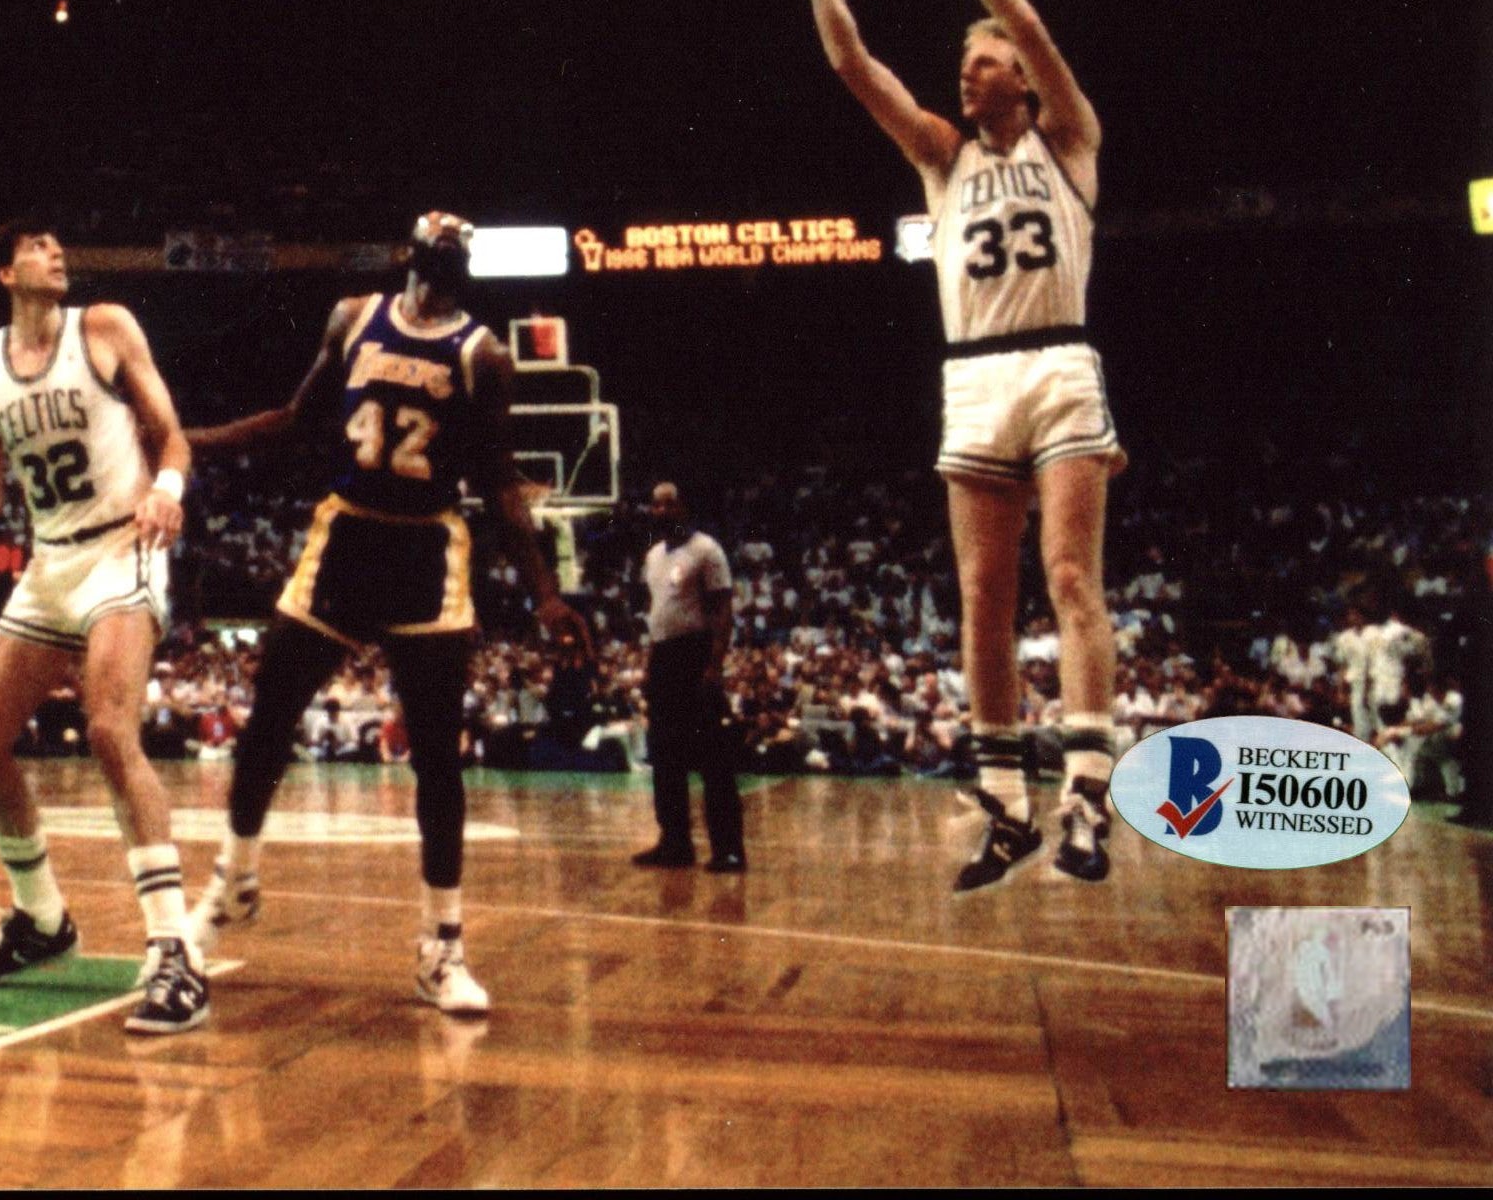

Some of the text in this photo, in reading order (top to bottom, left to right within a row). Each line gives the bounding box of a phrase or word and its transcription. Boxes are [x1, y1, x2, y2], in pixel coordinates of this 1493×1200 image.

[626, 219, 855, 248] BOSTON CELTICS
[699, 245, 764, 266] WORLD
[773, 240, 881, 264] CHAMPIONS
[964, 211, 1056, 280] 33
[21, 439, 95, 510] 32
[345, 400, 437, 481] 42
